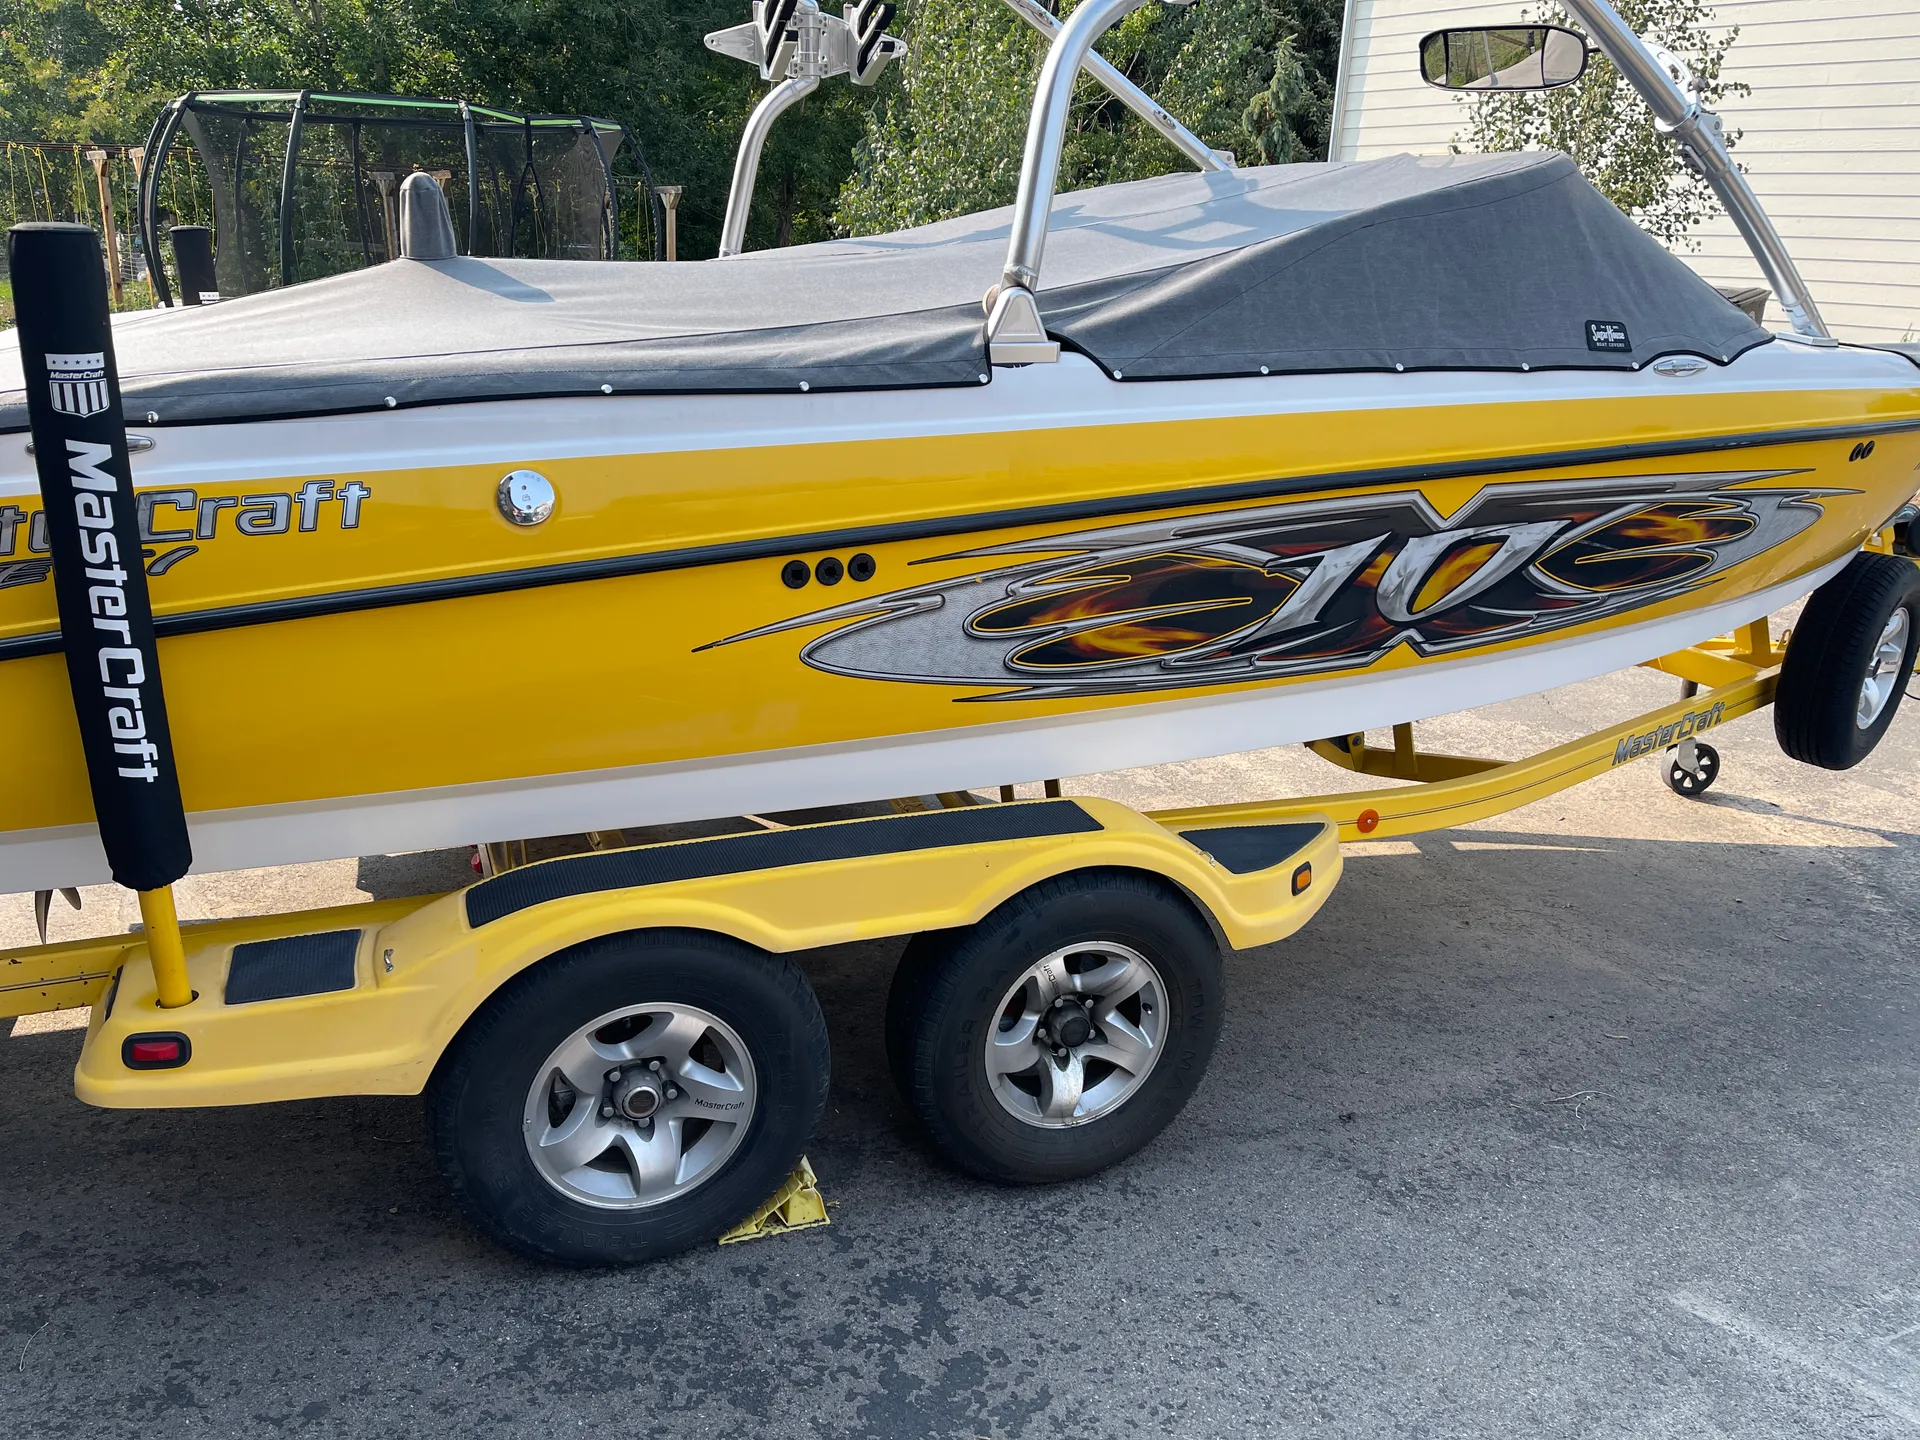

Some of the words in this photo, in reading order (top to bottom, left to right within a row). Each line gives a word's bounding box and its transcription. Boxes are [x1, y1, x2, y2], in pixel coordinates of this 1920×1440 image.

[50, 369, 104, 379] MasterCraft
[65, 439, 159, 783] MasterCraft
[1611, 701, 1726, 766] MasterCraft
[694, 1098, 745, 1110] MasterCraft
